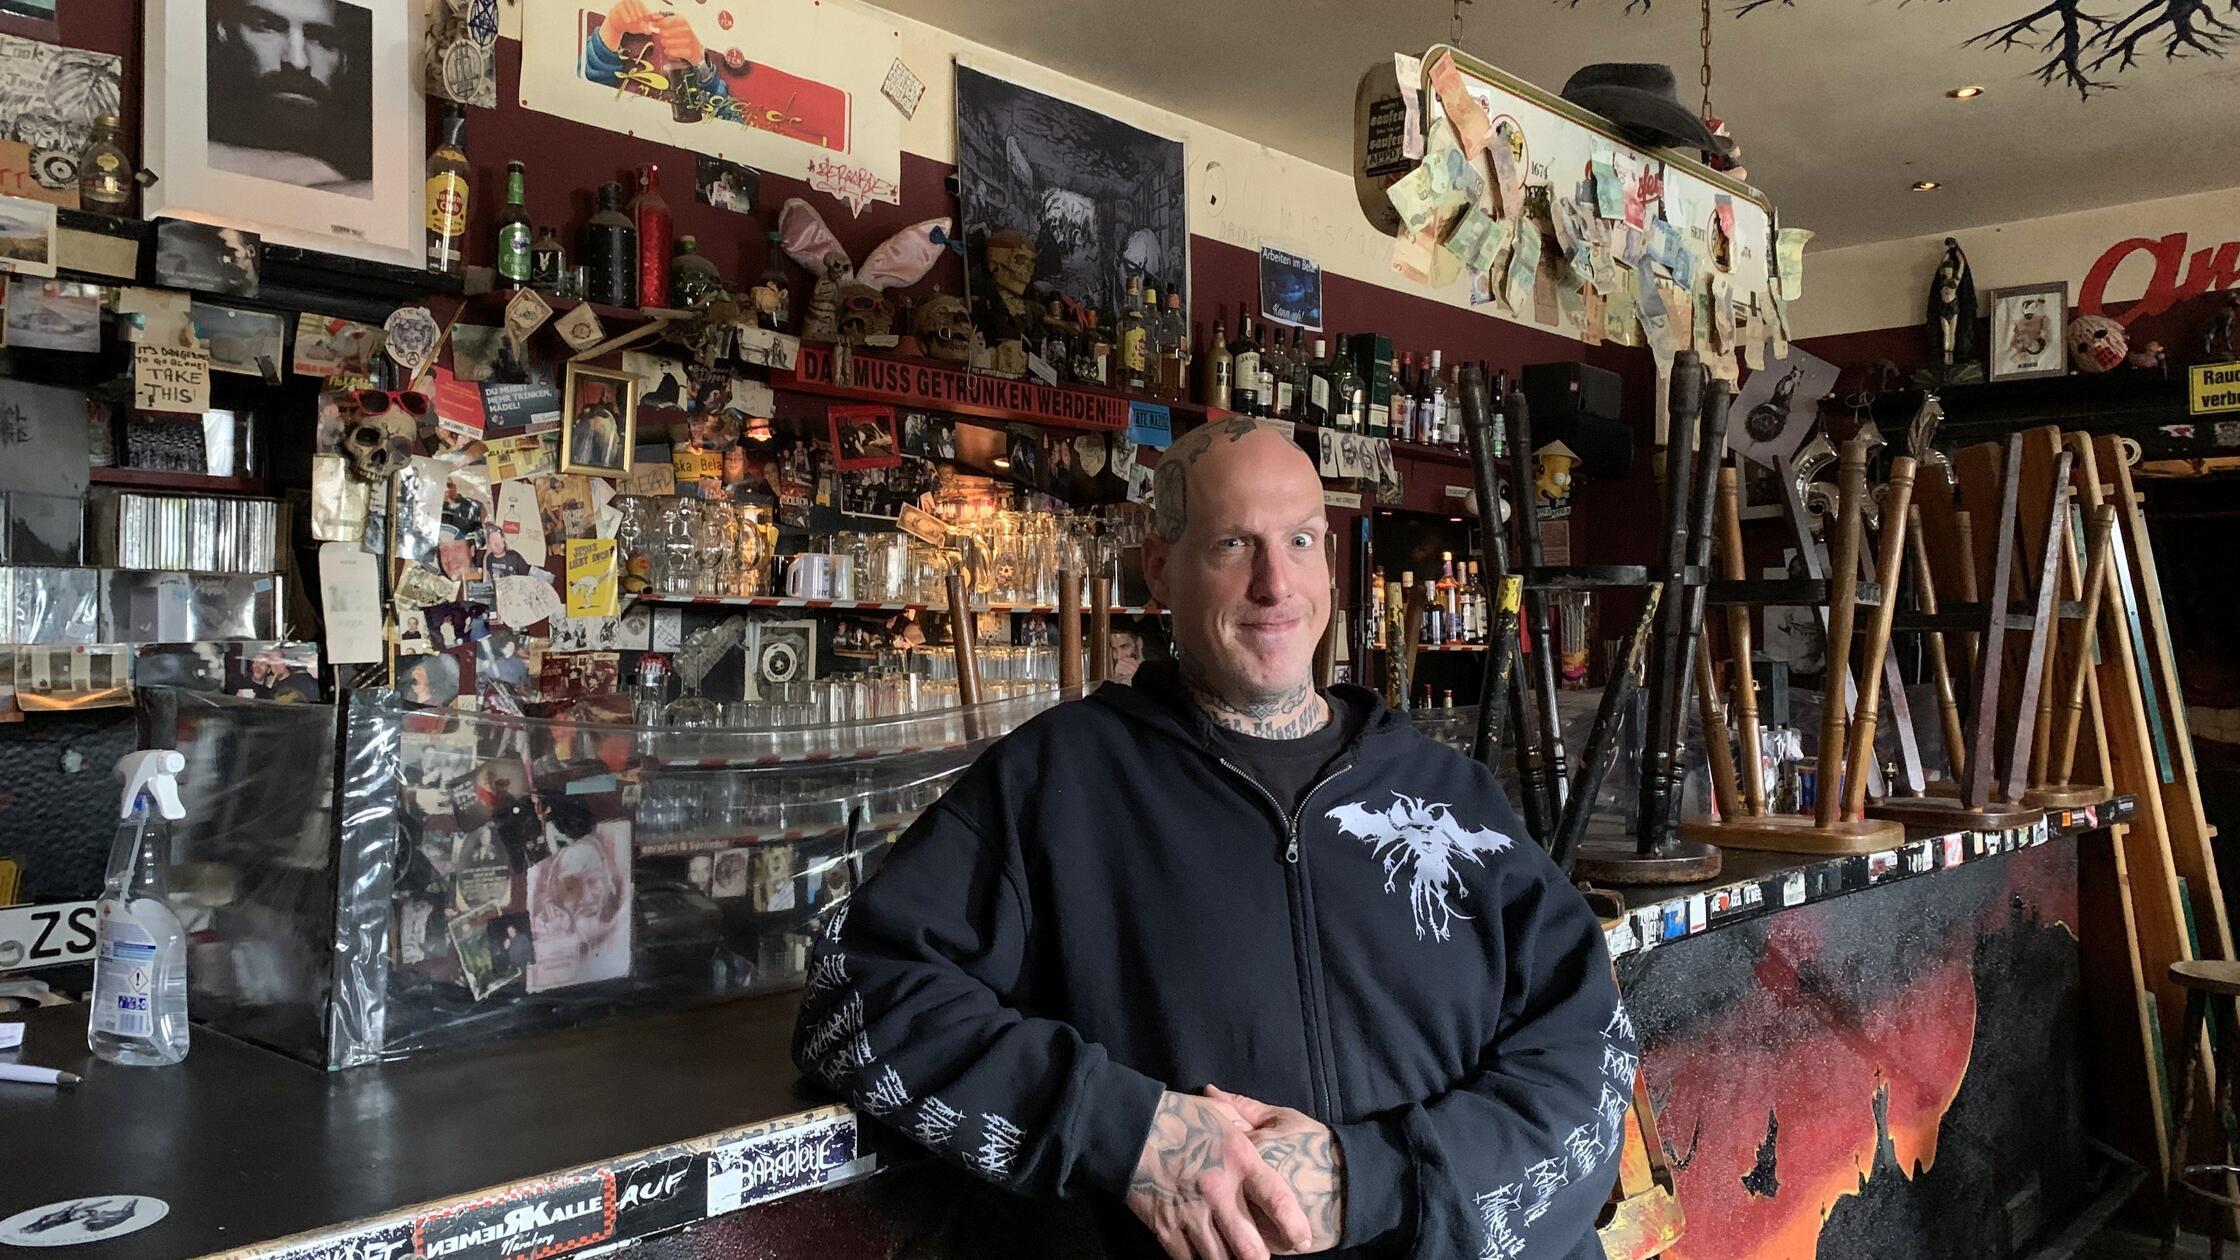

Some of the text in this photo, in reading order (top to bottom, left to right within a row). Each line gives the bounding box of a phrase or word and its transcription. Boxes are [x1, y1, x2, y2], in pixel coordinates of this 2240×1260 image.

[1262, 248, 1292, 266] Arbeiten
[1293, 258, 1301, 268] im
[154, 358, 167, 366] GO
[146, 368, 203, 385] TAKE
[144, 383, 197, 406] THIS!
[485, 387, 498, 396] DU
[486, 389, 552, 405] MEHR TRINKEN,
[803, 350, 1123, 426] DA MUSS GETRUNKEN WERDEN!!!
[619, 1169, 690, 1211] AUF
